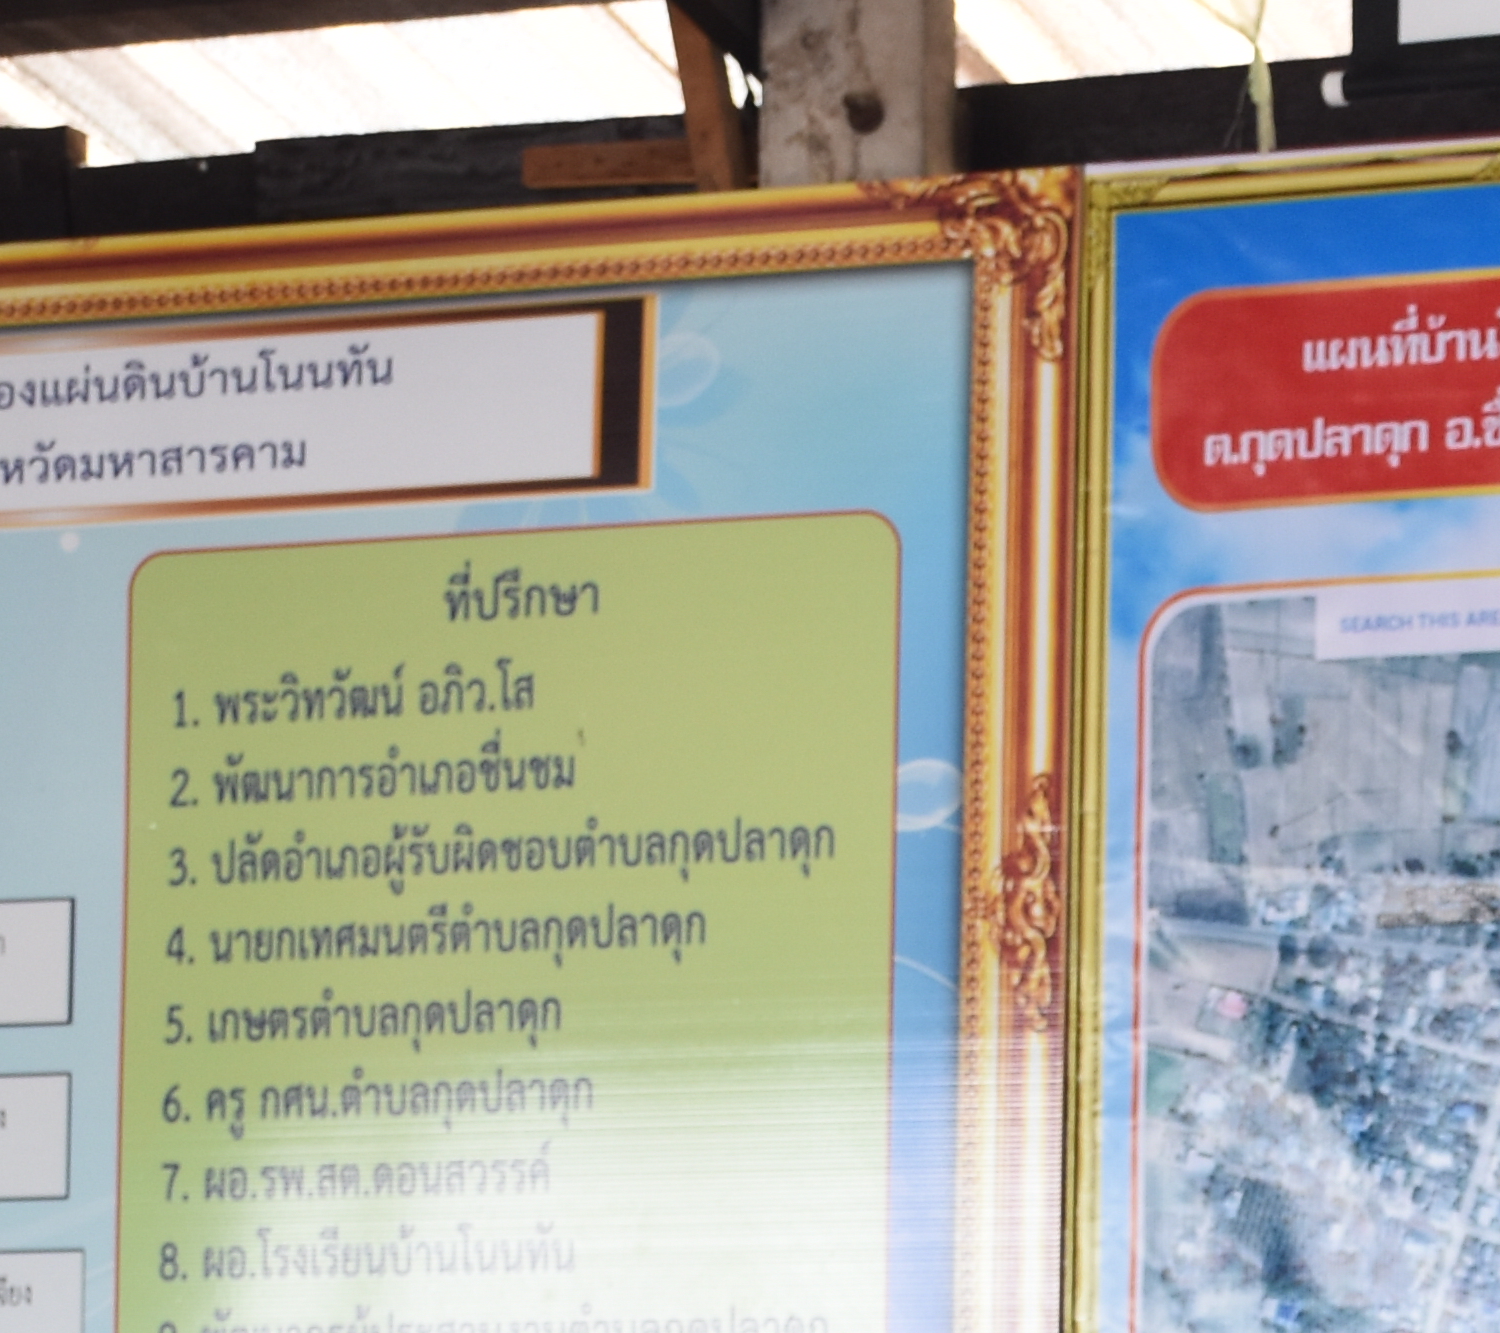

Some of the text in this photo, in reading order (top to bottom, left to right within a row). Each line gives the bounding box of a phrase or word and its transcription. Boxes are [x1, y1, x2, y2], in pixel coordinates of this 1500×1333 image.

[1204, 417, 1429, 476] ต.กุดปลาดุก
[444, 565, 599, 622] ที่ปรึกษา
[1340, 615, 1413, 633] SEARCH
[1417, 611, 1461, 629] THIS
[174, 690, 200, 728] 1.
[169, 767, 198, 808] 2.
[168, 847, 197, 887] 3.
[166, 926, 195, 964] 4.
[164, 1004, 193, 1045] 5.
[162, 1084, 190, 1124] 6.
[206, 1087, 245, 1140] ครู
[161, 1162, 189, 1201] 7.
[159, 1241, 187, 1282] 8.
